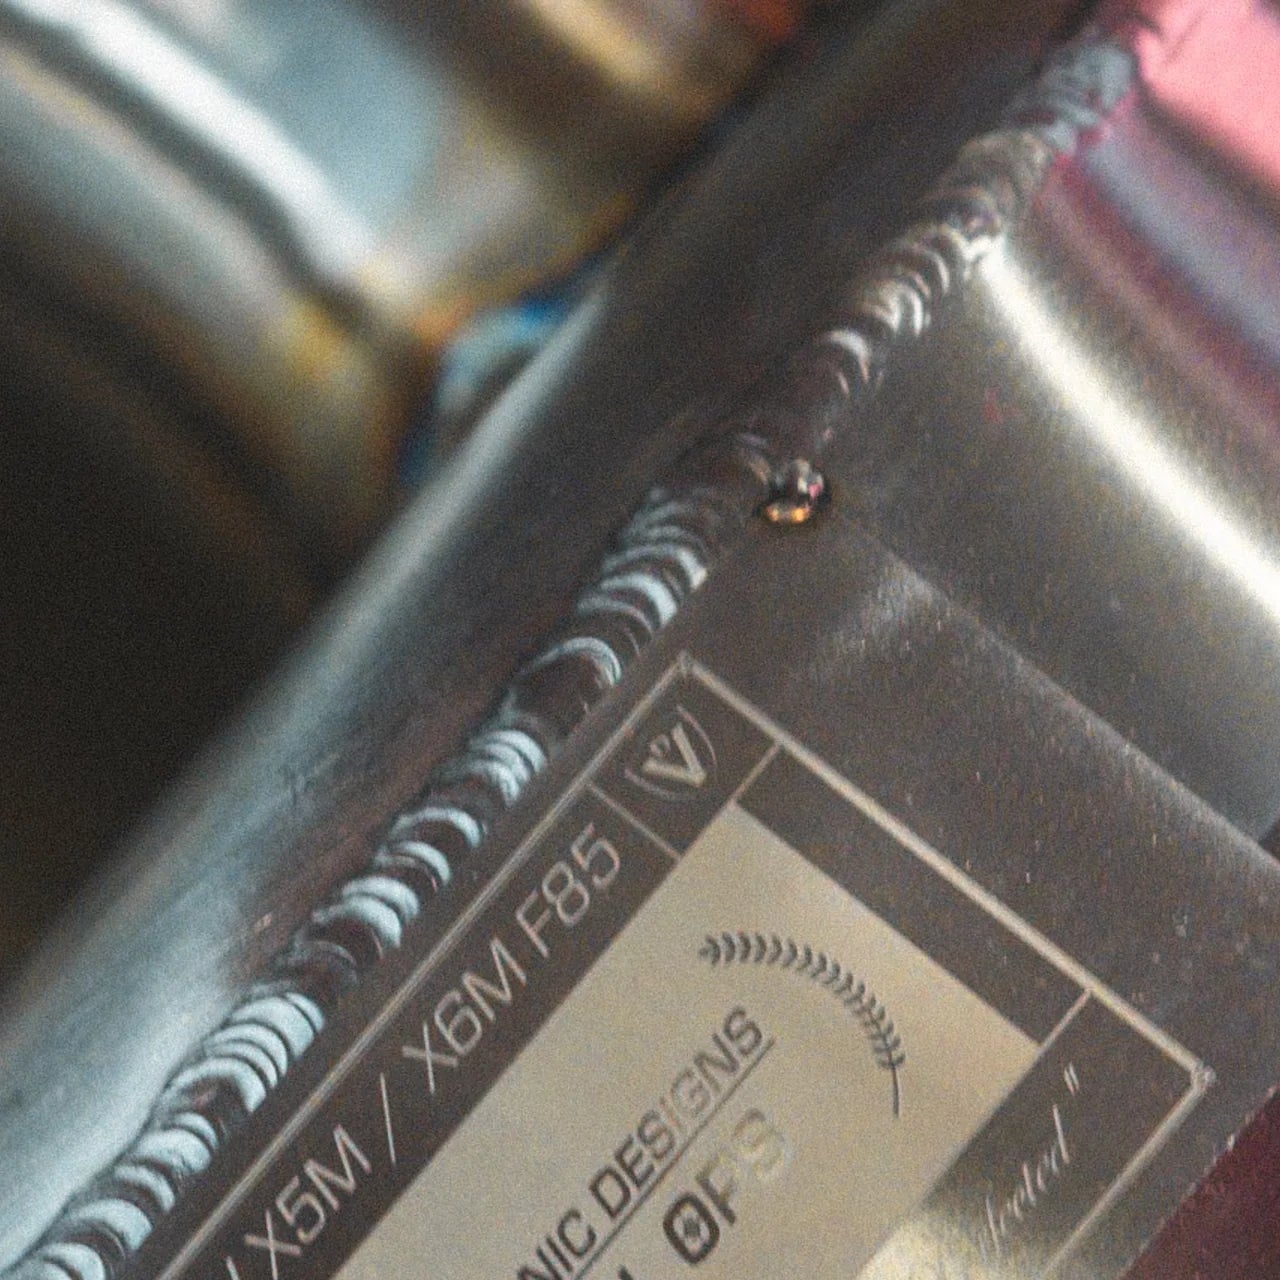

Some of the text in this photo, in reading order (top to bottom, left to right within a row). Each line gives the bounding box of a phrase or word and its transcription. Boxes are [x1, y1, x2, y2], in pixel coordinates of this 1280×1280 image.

[401, 936, 527, 1096] X6M
[514, 821, 621, 959] F85
[588, 1006, 764, 1220] DESIGNS
[661, 1106, 793, 1267] OPS
